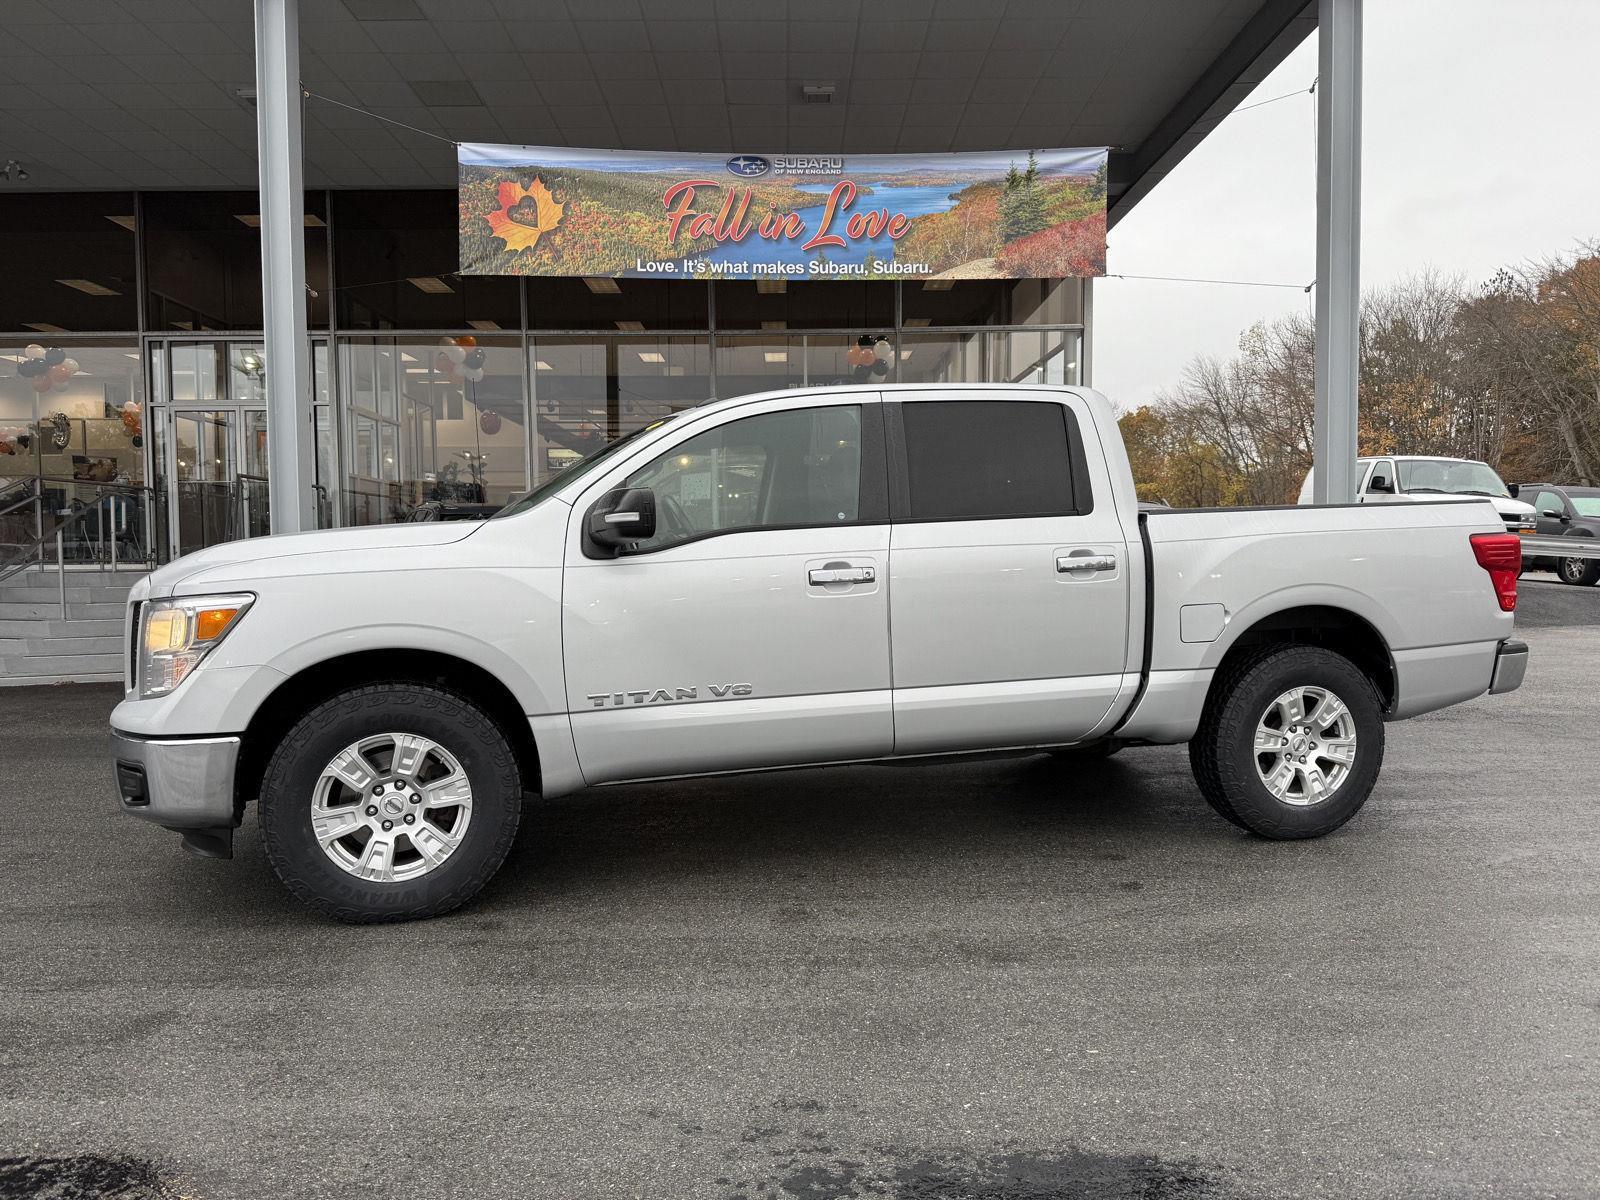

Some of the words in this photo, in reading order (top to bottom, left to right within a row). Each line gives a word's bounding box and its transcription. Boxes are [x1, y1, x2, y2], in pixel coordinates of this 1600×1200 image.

[774, 158, 842, 168] SUBARU
[662, 179, 754, 245] Fall
[758, 202, 806, 240] in
[801, 179, 913, 251] Love
[636, 258, 679, 273] Love.
[709, 260, 749, 274] what
[753, 260, 805, 274] makes
[808, 260, 868, 277] Subaru,
[873, 260, 934, 274] Subaru.
[587, 685, 698, 707] TITAN
[707, 682, 753, 697] V8
